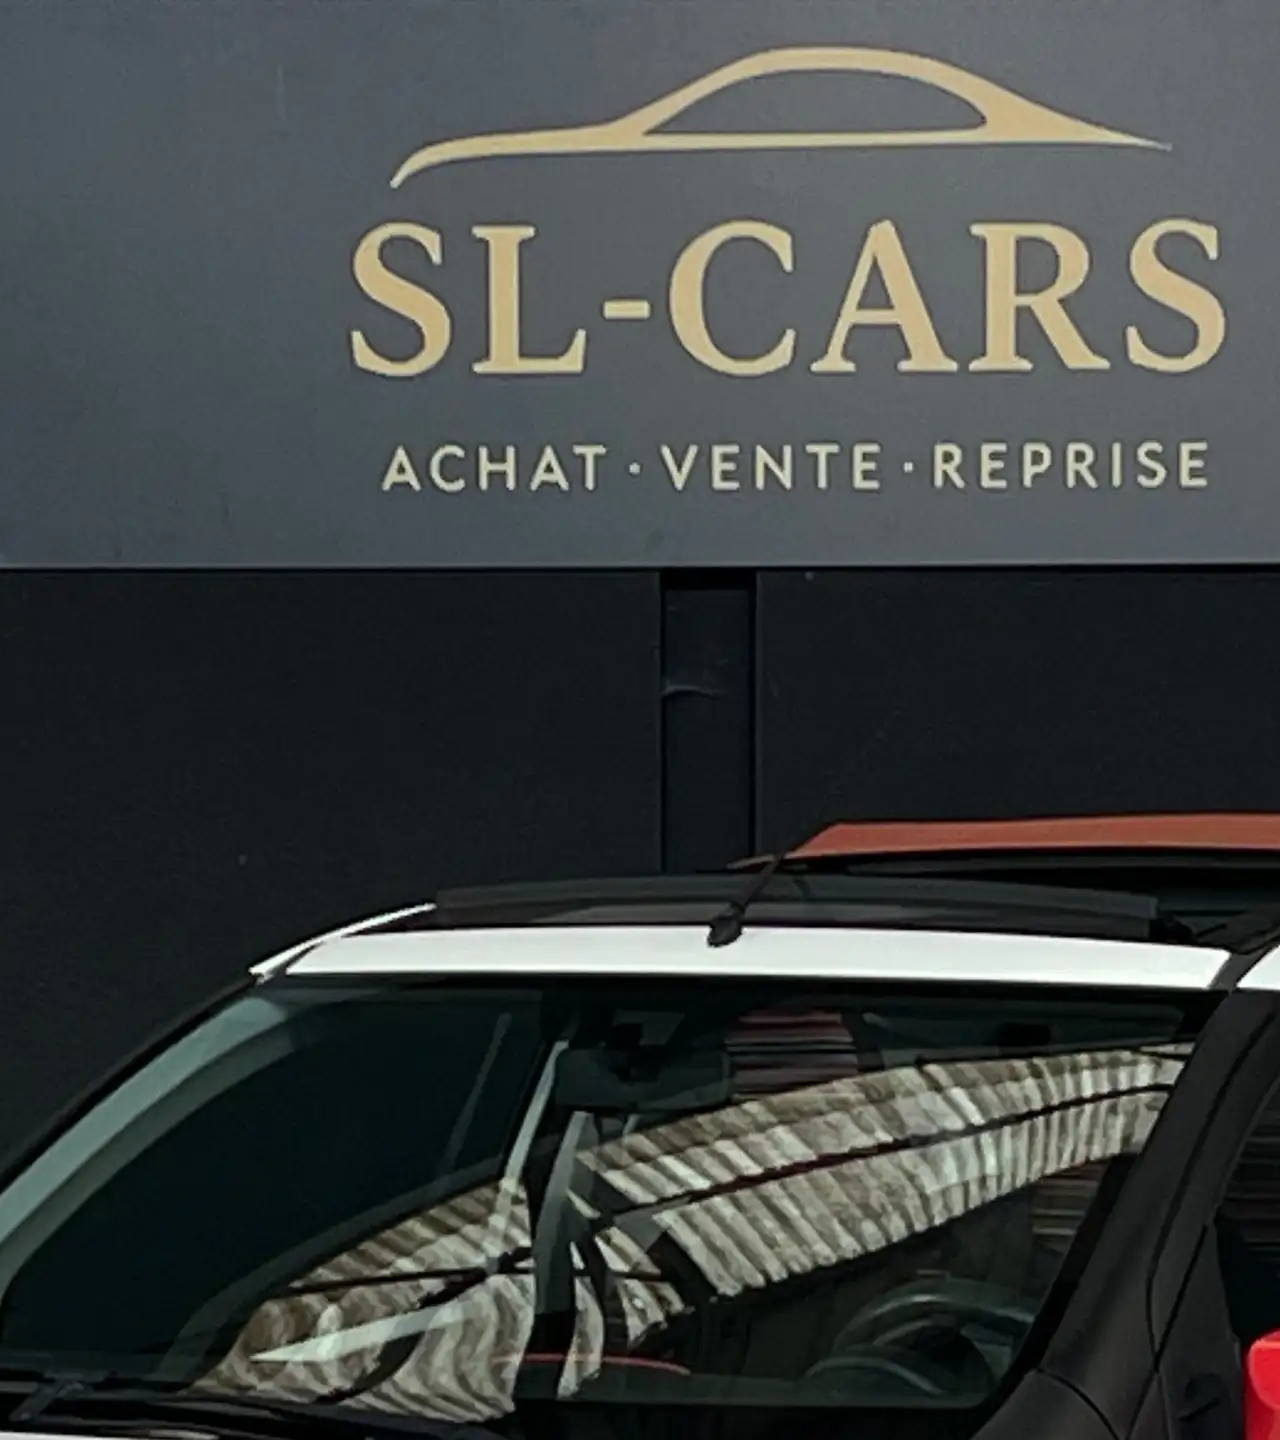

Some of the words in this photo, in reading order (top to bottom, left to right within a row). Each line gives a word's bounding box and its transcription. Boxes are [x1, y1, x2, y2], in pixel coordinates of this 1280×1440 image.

[350, 218, 1227, 378] SL-CARS
[381, 444, 608, 492] ACHAT
[660, 442, 882, 491] VENTE
[933, 440, 1209, 490] REPRISE
